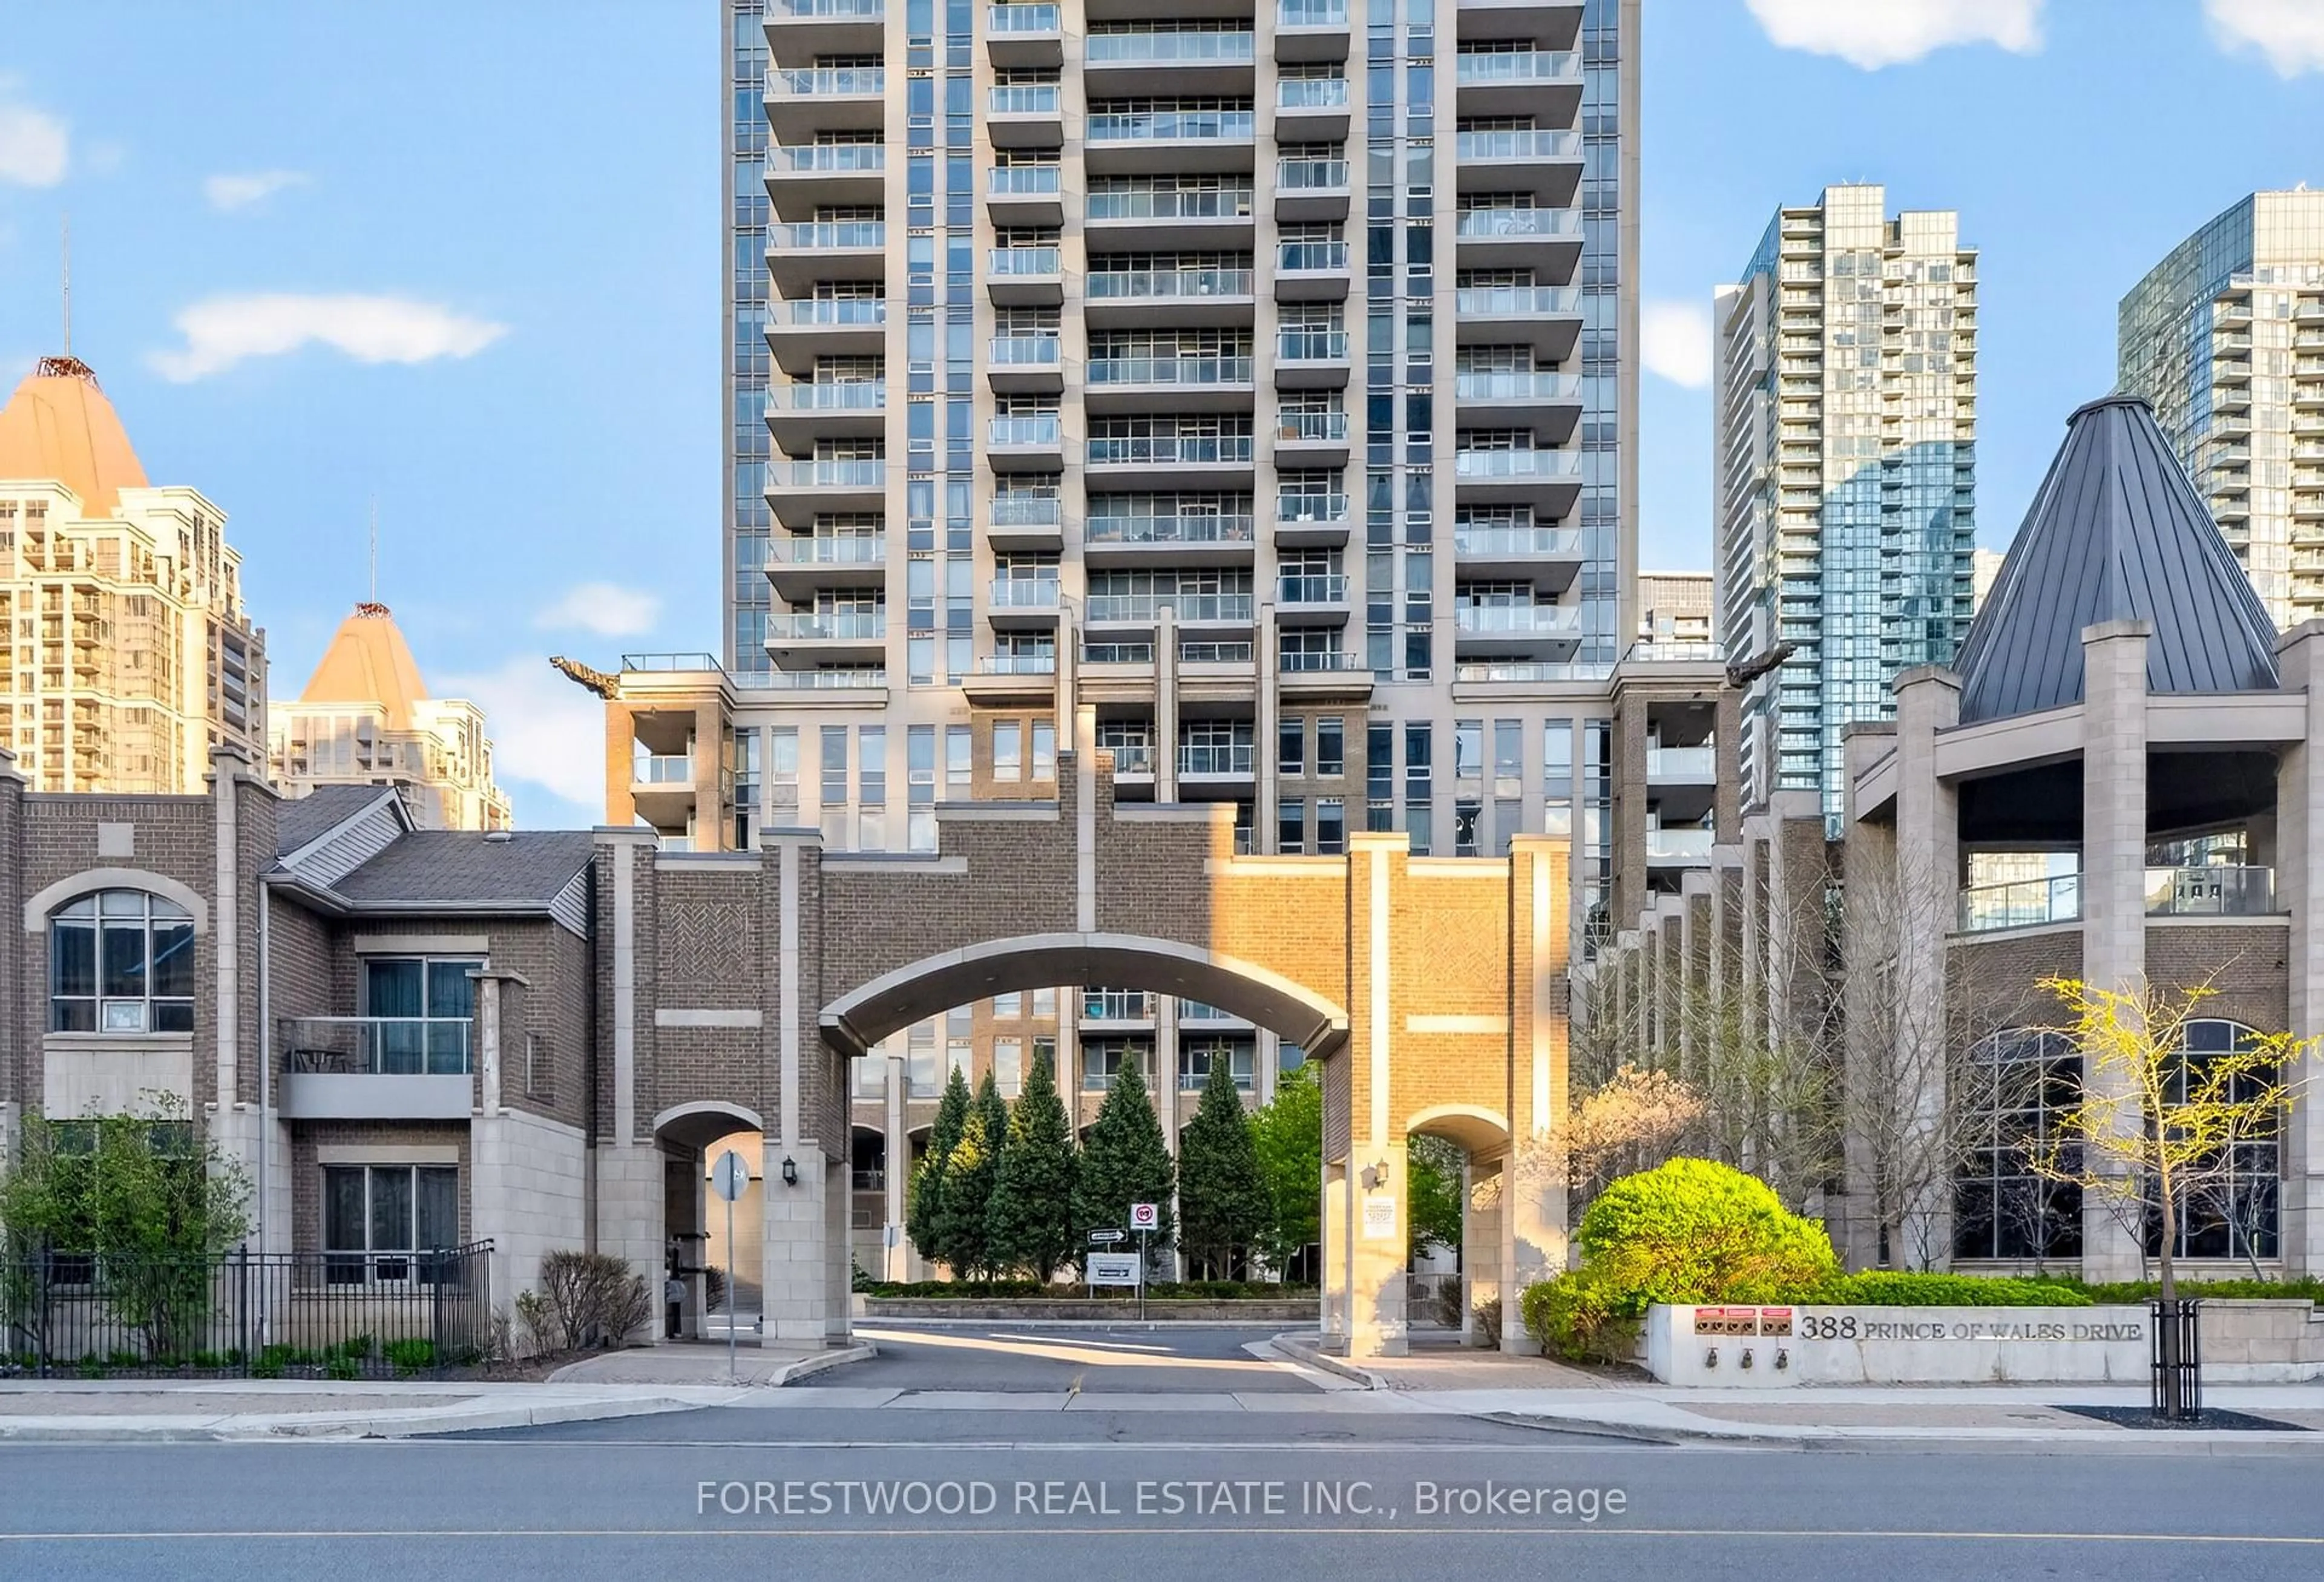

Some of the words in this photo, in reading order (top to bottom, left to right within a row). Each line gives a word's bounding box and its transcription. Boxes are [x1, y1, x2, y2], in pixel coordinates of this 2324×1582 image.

[1801, 1316, 1857, 1339] 388
[1864, 1322, 1946, 1339] PRINCE
[1952, 1323, 1983, 1339] OF
[1989, 1323, 2065, 1339] WALES
[2072, 1324, 2142, 1341] DRIVE
